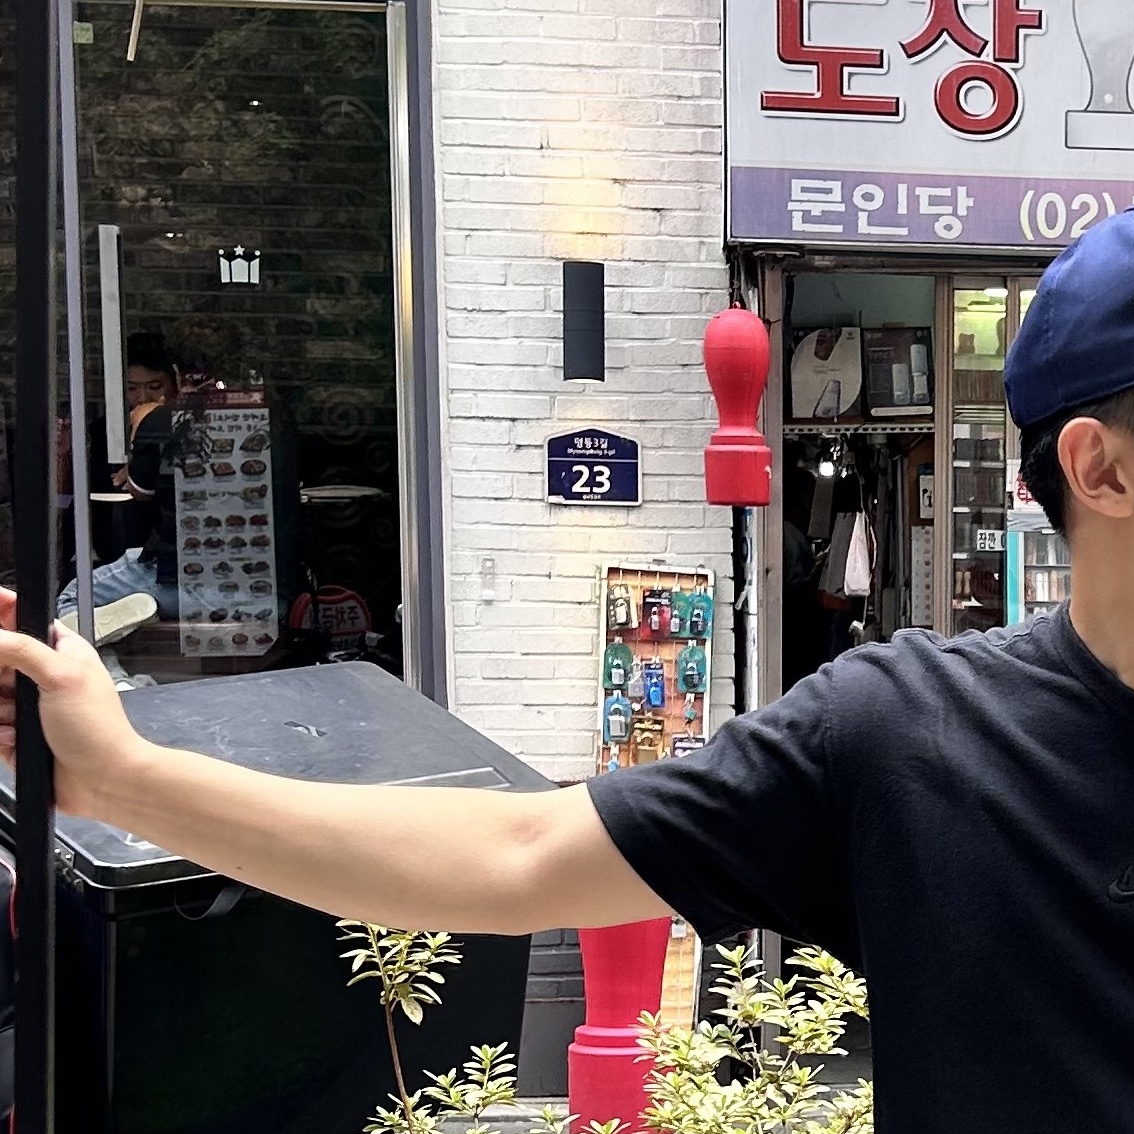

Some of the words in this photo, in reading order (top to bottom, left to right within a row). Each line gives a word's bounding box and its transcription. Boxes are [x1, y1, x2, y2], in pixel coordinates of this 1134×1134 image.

[786, 178, 975, 241] 문인당
[1019, 189, 1116, 241] (02)
[571, 464, 612, 494] 23
